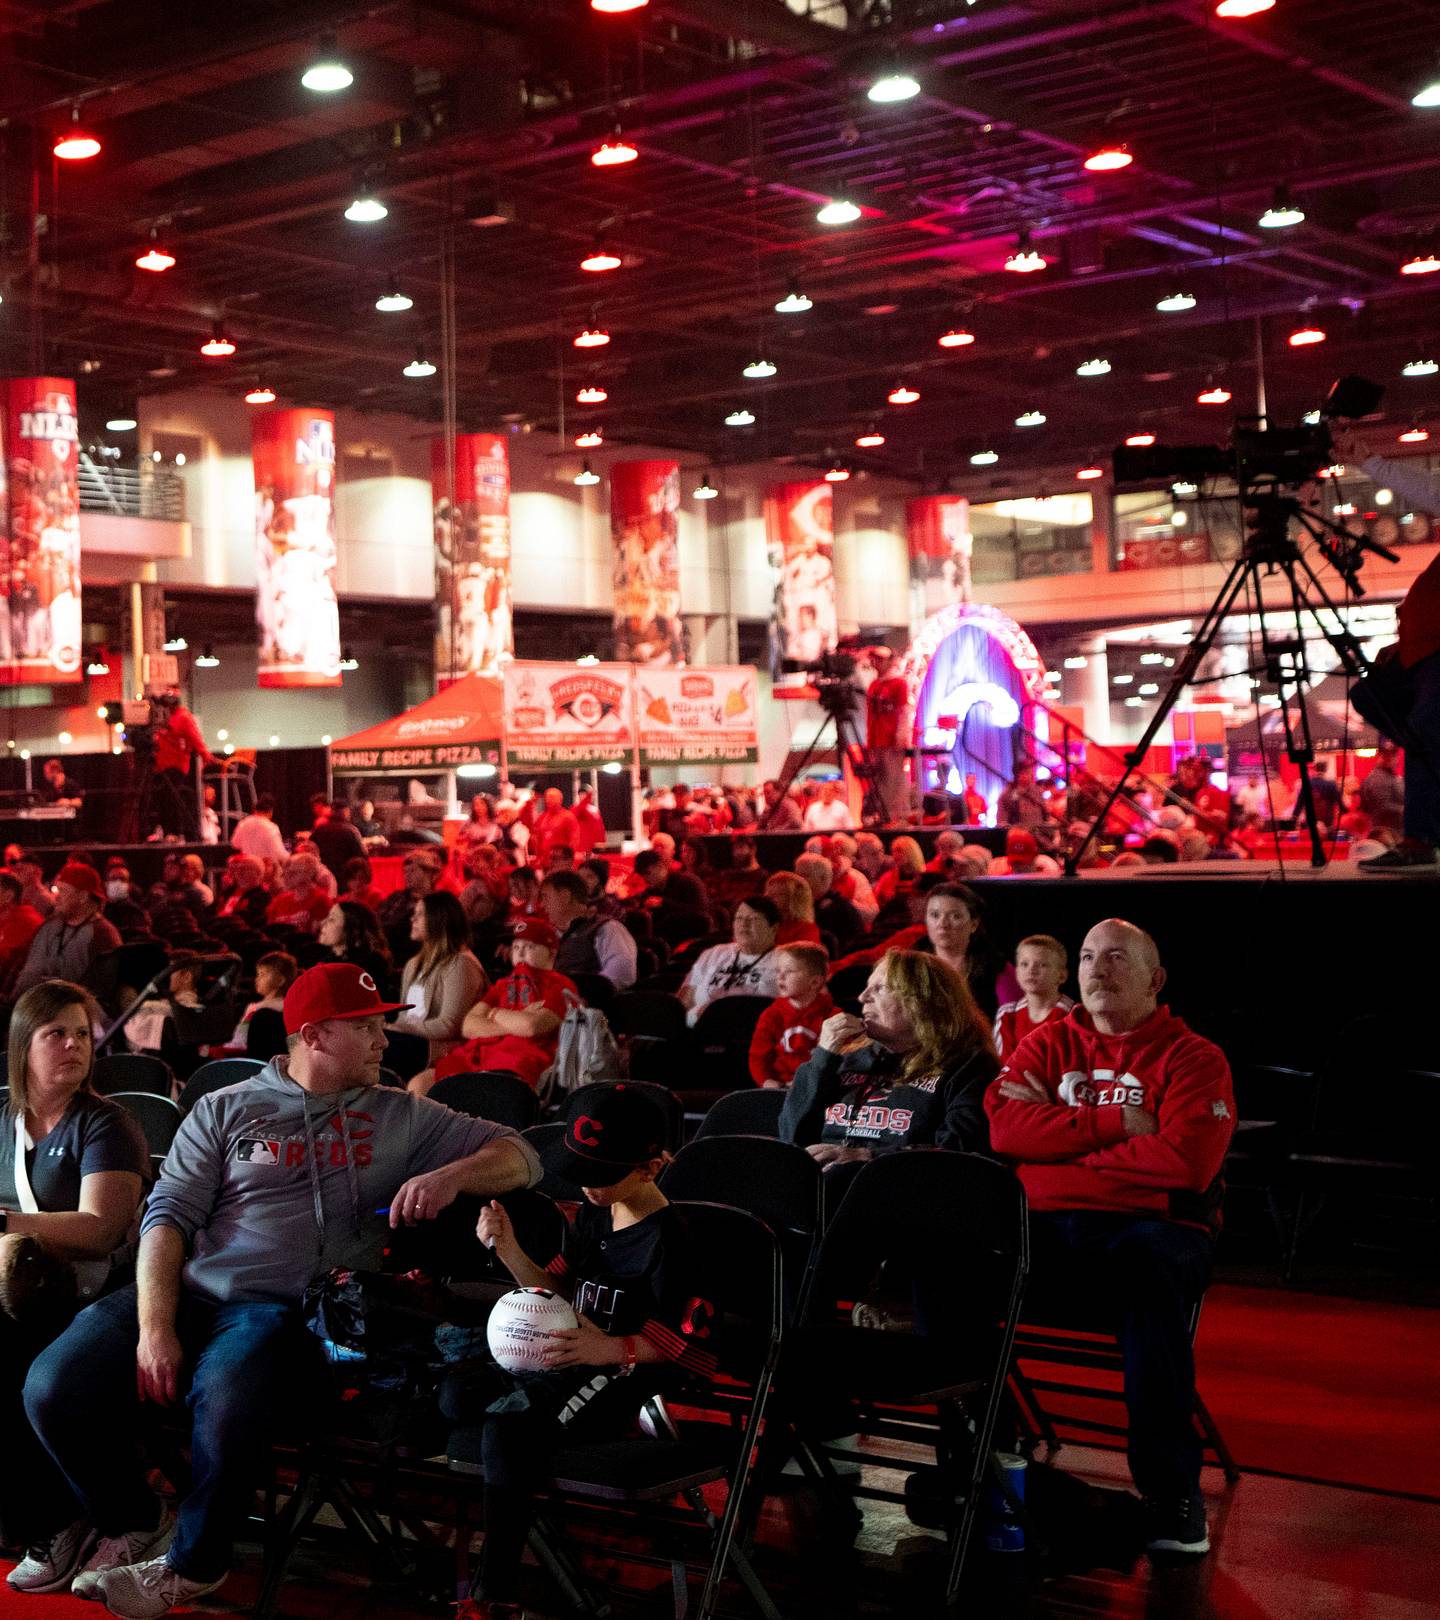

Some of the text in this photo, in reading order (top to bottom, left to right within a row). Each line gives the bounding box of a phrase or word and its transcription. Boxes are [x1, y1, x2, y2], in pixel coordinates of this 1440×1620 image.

[331, 746, 482, 767] FAMILY RECIPE PIZZA
[1078, 1085, 1144, 1106] REDS
[824, 1102, 915, 1133] REDS
[241, 1130, 337, 1142] CINCINNTI
[285, 1141, 374, 1168] REDS
